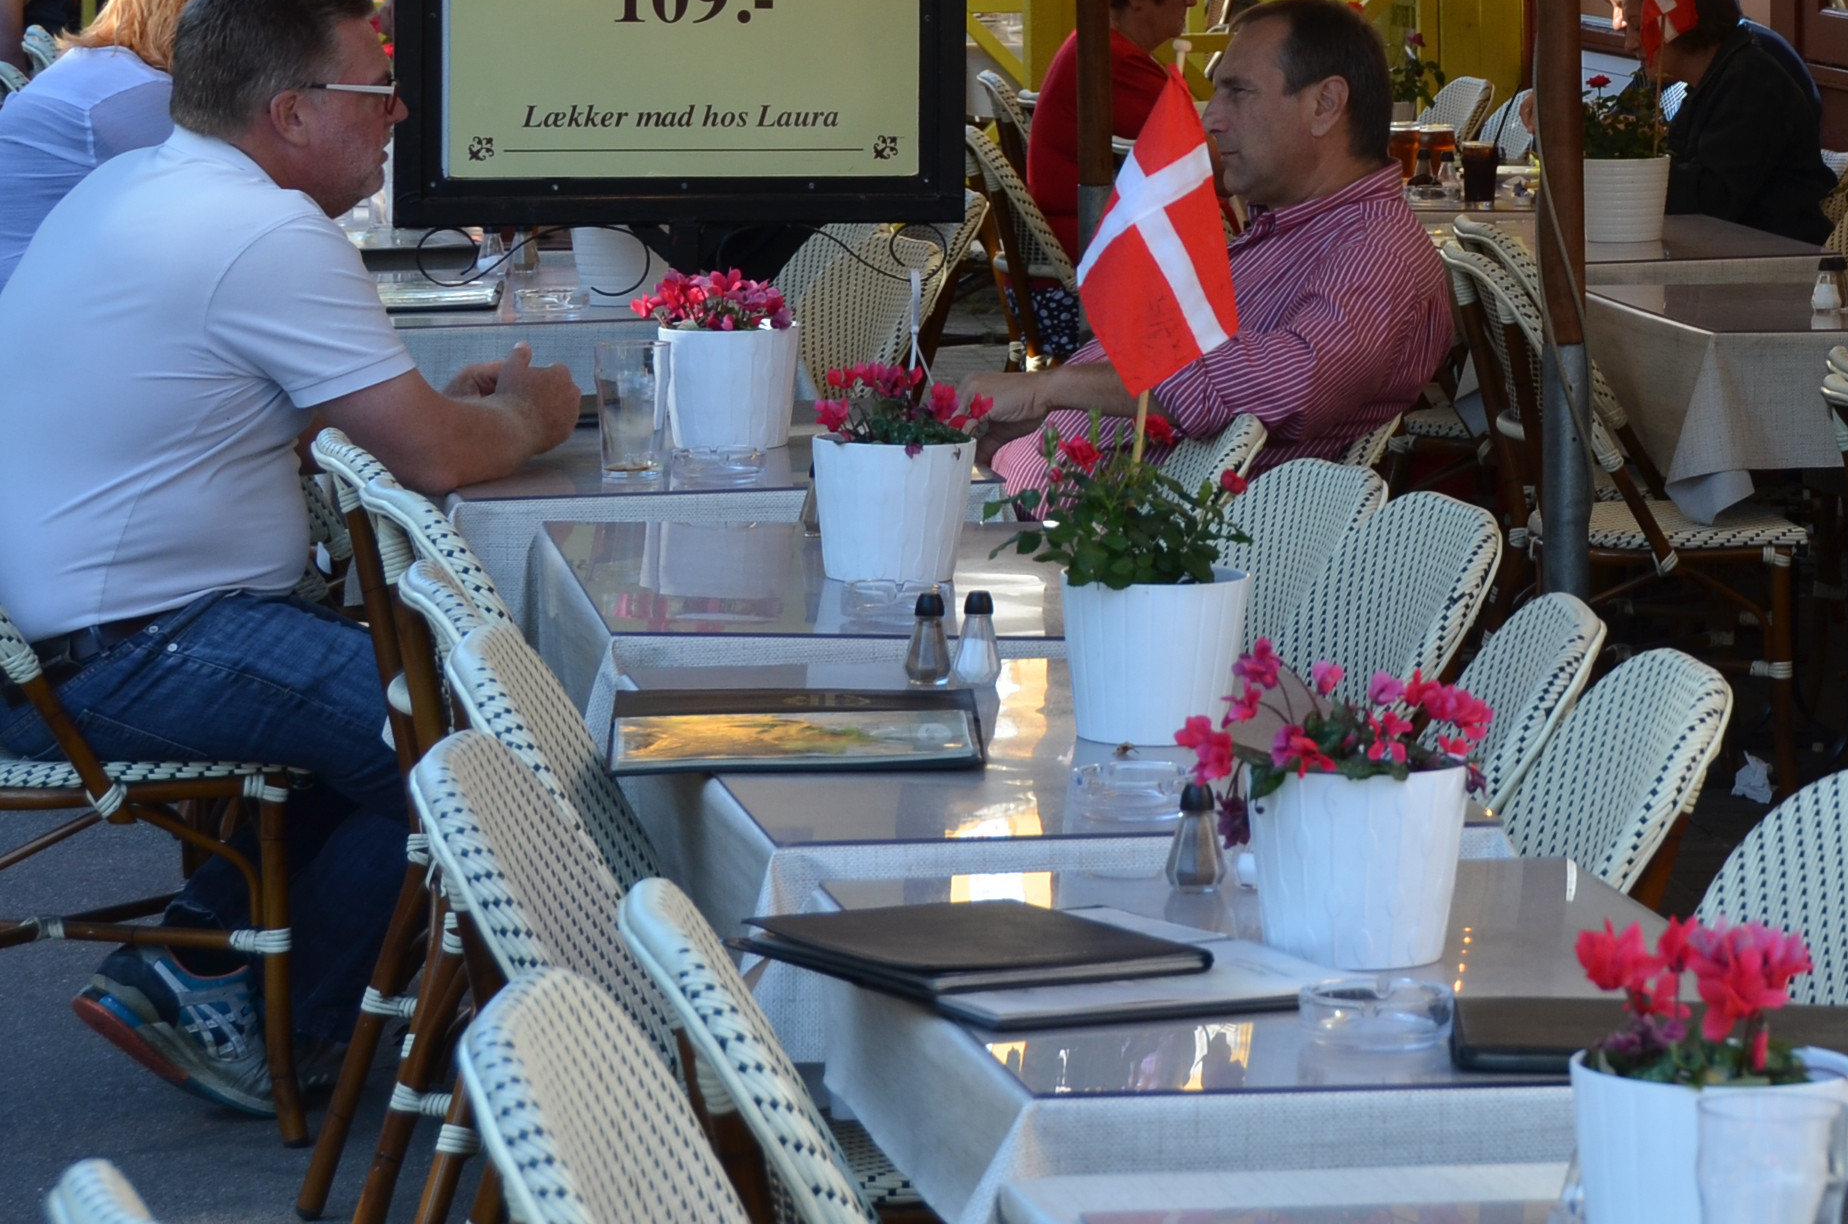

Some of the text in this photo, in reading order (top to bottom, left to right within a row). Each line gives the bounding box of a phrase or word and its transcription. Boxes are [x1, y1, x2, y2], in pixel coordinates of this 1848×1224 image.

[522, 104, 840, 128] Lækker mad hos Laura
